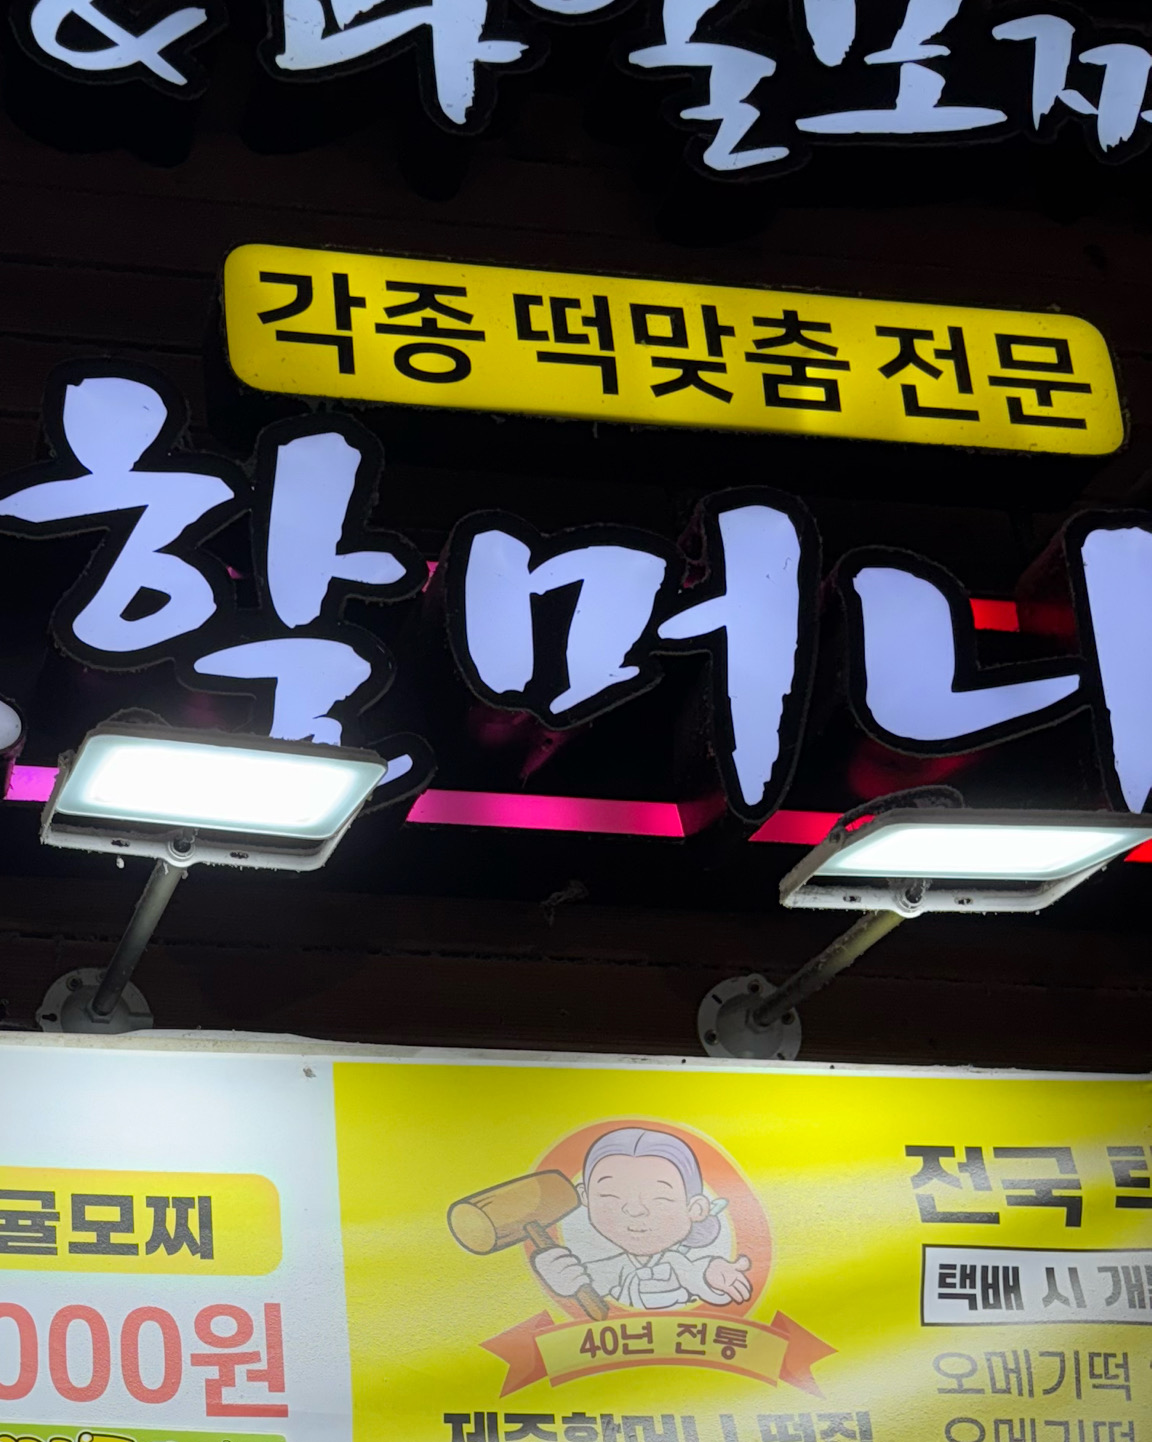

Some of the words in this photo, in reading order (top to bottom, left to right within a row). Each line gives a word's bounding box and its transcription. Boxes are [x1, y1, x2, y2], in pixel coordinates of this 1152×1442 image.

[256, 270, 486, 385] 각종
[512, 291, 851, 414] 떡맞춤
[873, 323, 1093, 431] 전문
[904, 1145, 1083, 1228] 전국
[937, 1263, 1025, 1312] 택배
[1042, 1266, 1087, 1309] 시
[1097, 1265, 1152, 1310] 개
[579, 1321, 654, 1358] 40년
[675, 1322, 749, 1361] 전통
[932, 1349, 1132, 1401] 오메기떡
